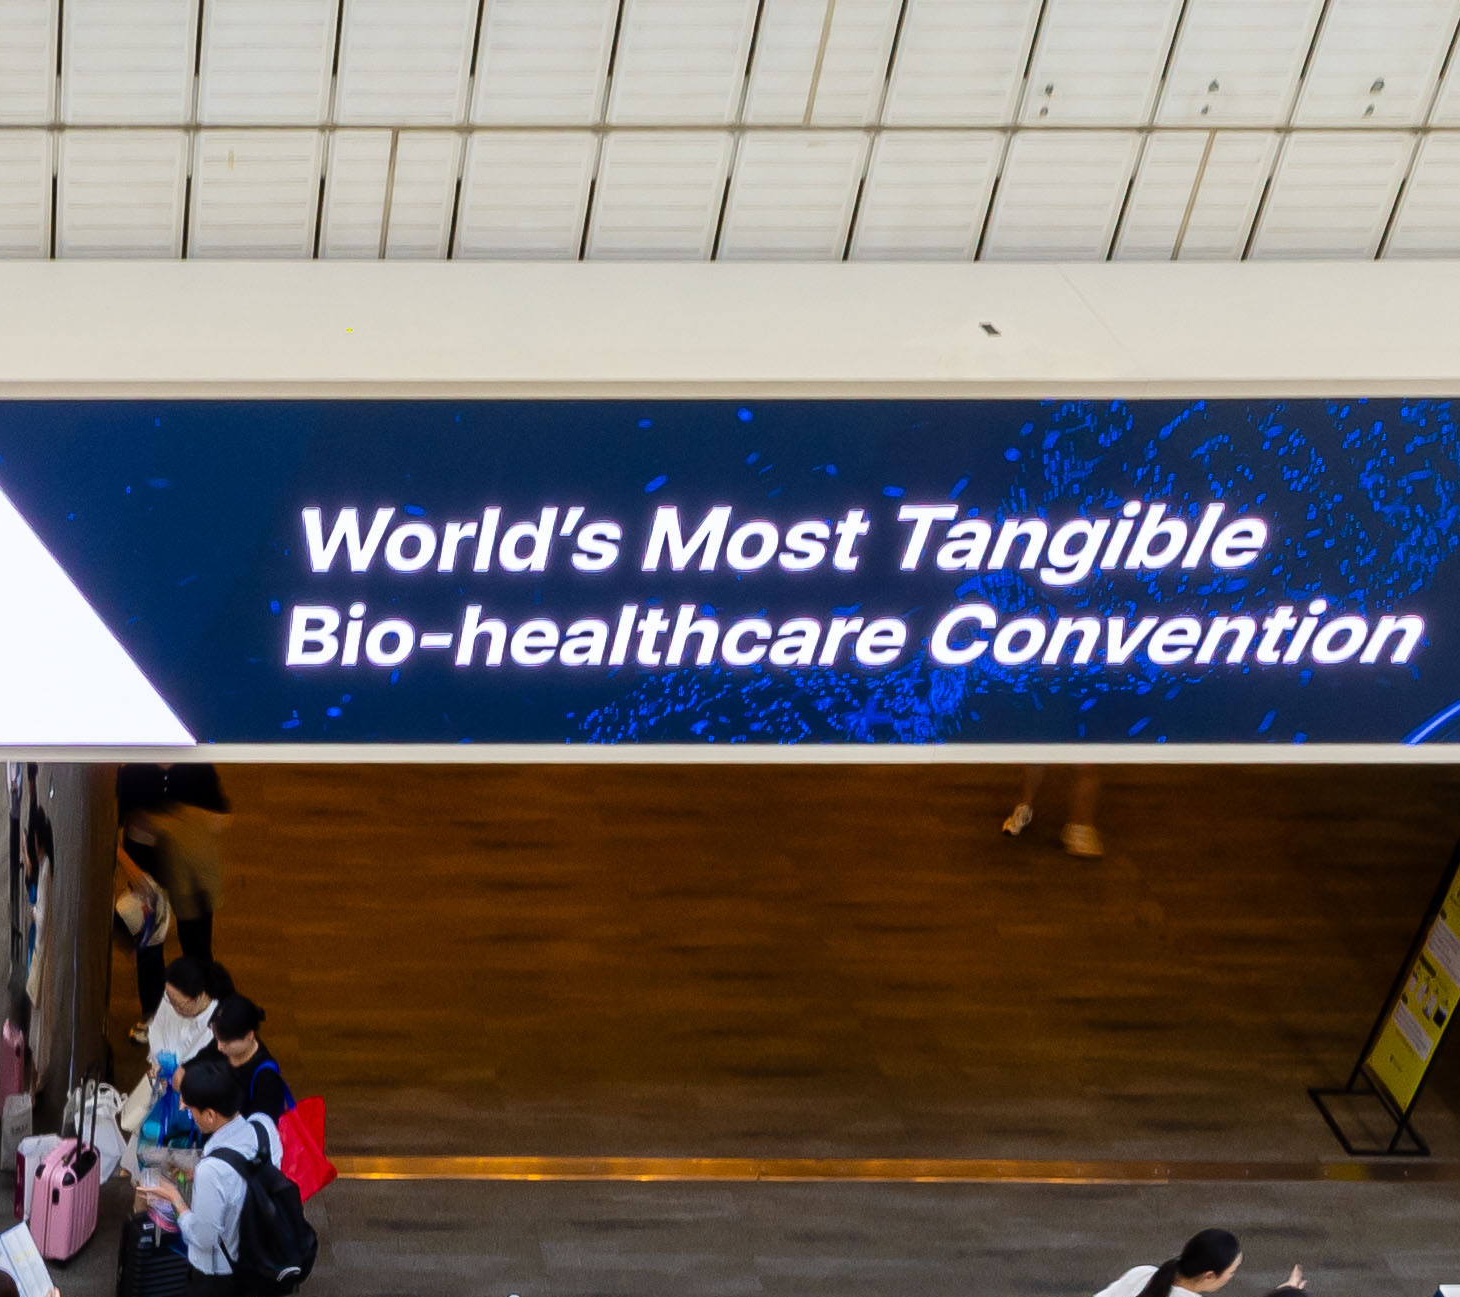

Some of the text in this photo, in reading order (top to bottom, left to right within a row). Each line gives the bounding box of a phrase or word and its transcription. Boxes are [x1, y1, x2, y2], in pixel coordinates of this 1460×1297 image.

[641, 505, 869, 574] Most
[894, 503, 1269, 587] Tangible
[286, 599, 1426, 668] Bio-healthcare Convention
